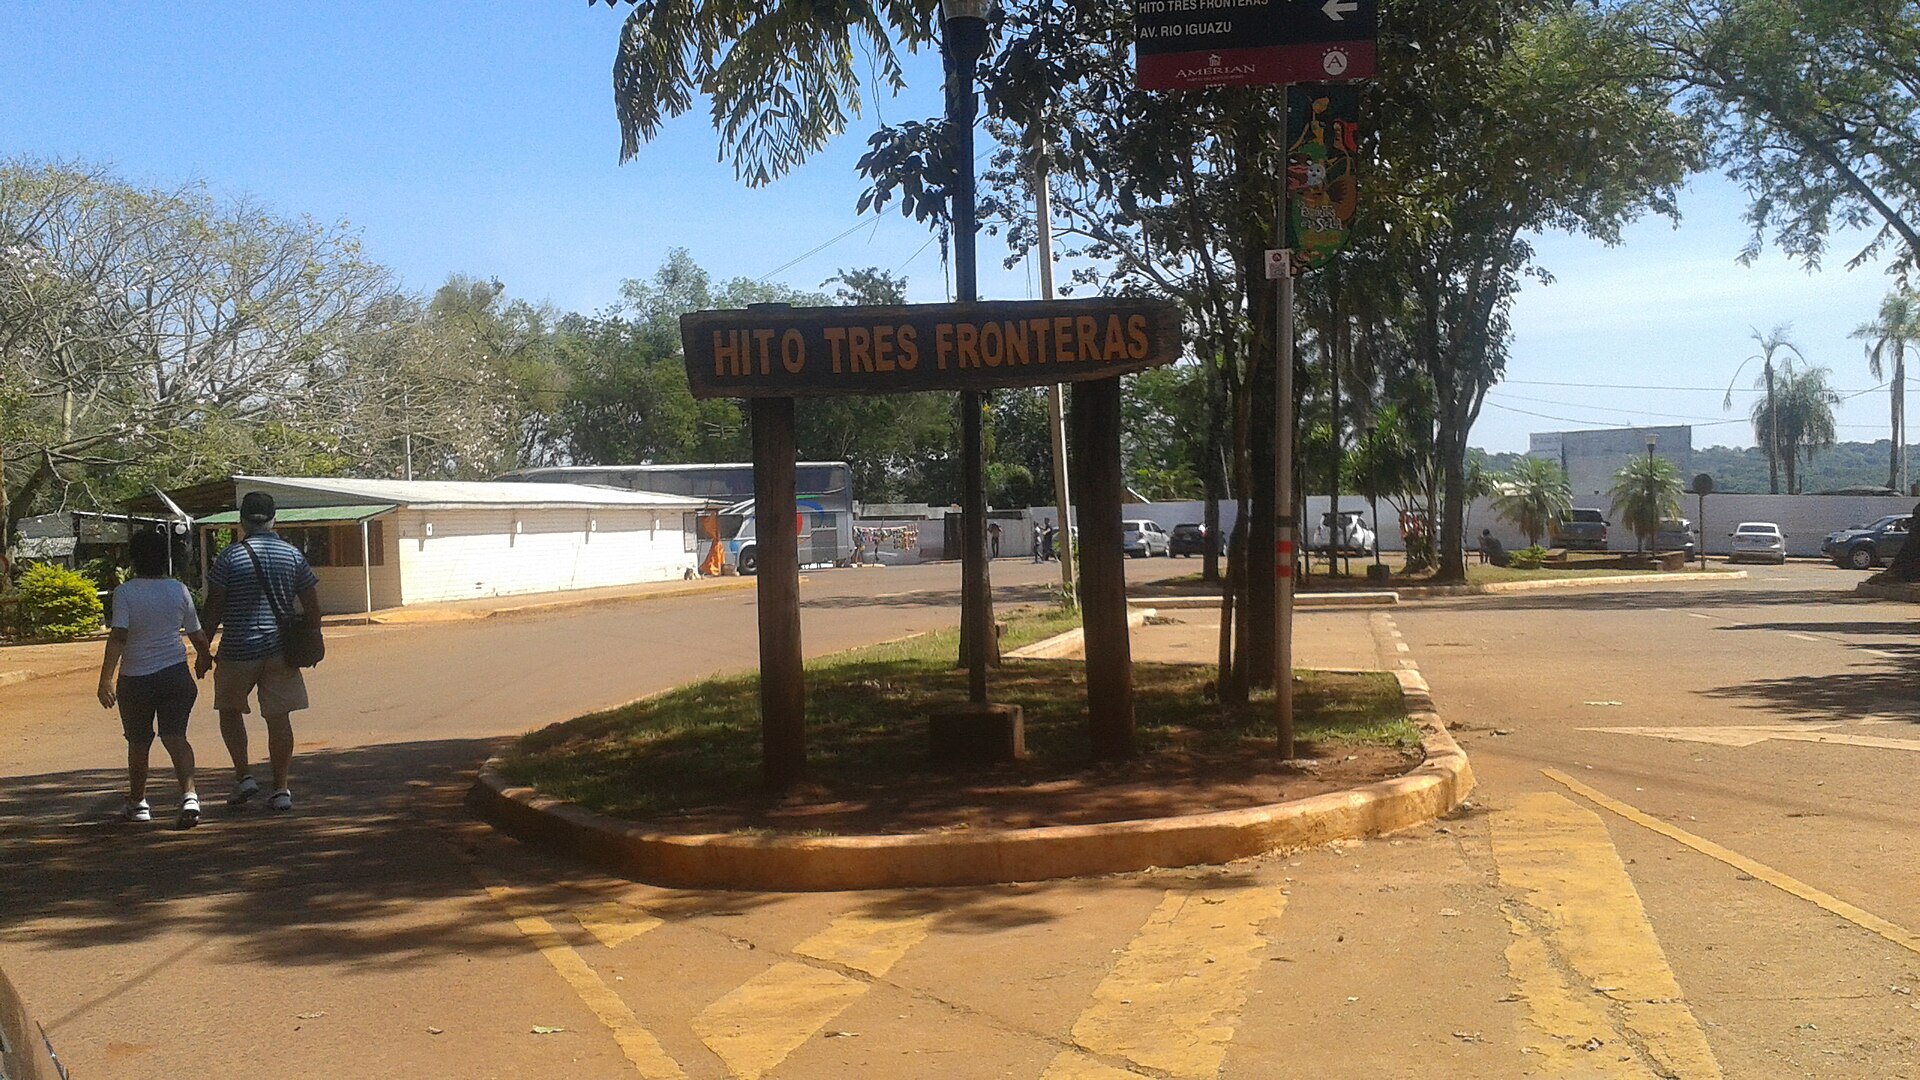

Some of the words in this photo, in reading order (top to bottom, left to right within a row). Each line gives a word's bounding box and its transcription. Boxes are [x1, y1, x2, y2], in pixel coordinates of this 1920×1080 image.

[1139, 2, 1165, 13] HITO
[1167, 0, 1197, 12] TRES
[1139, 26, 1158, 39] AV.
[1160, 24, 1182, 37] RIO
[1185, 21, 1232, 36] IGUAZU
[1175, 64, 1256, 78] AMERIAN
[712, 327, 806, 377] HITO
[823, 324, 920, 374] TRES
[935, 313, 1149, 370] FRONTERAS
